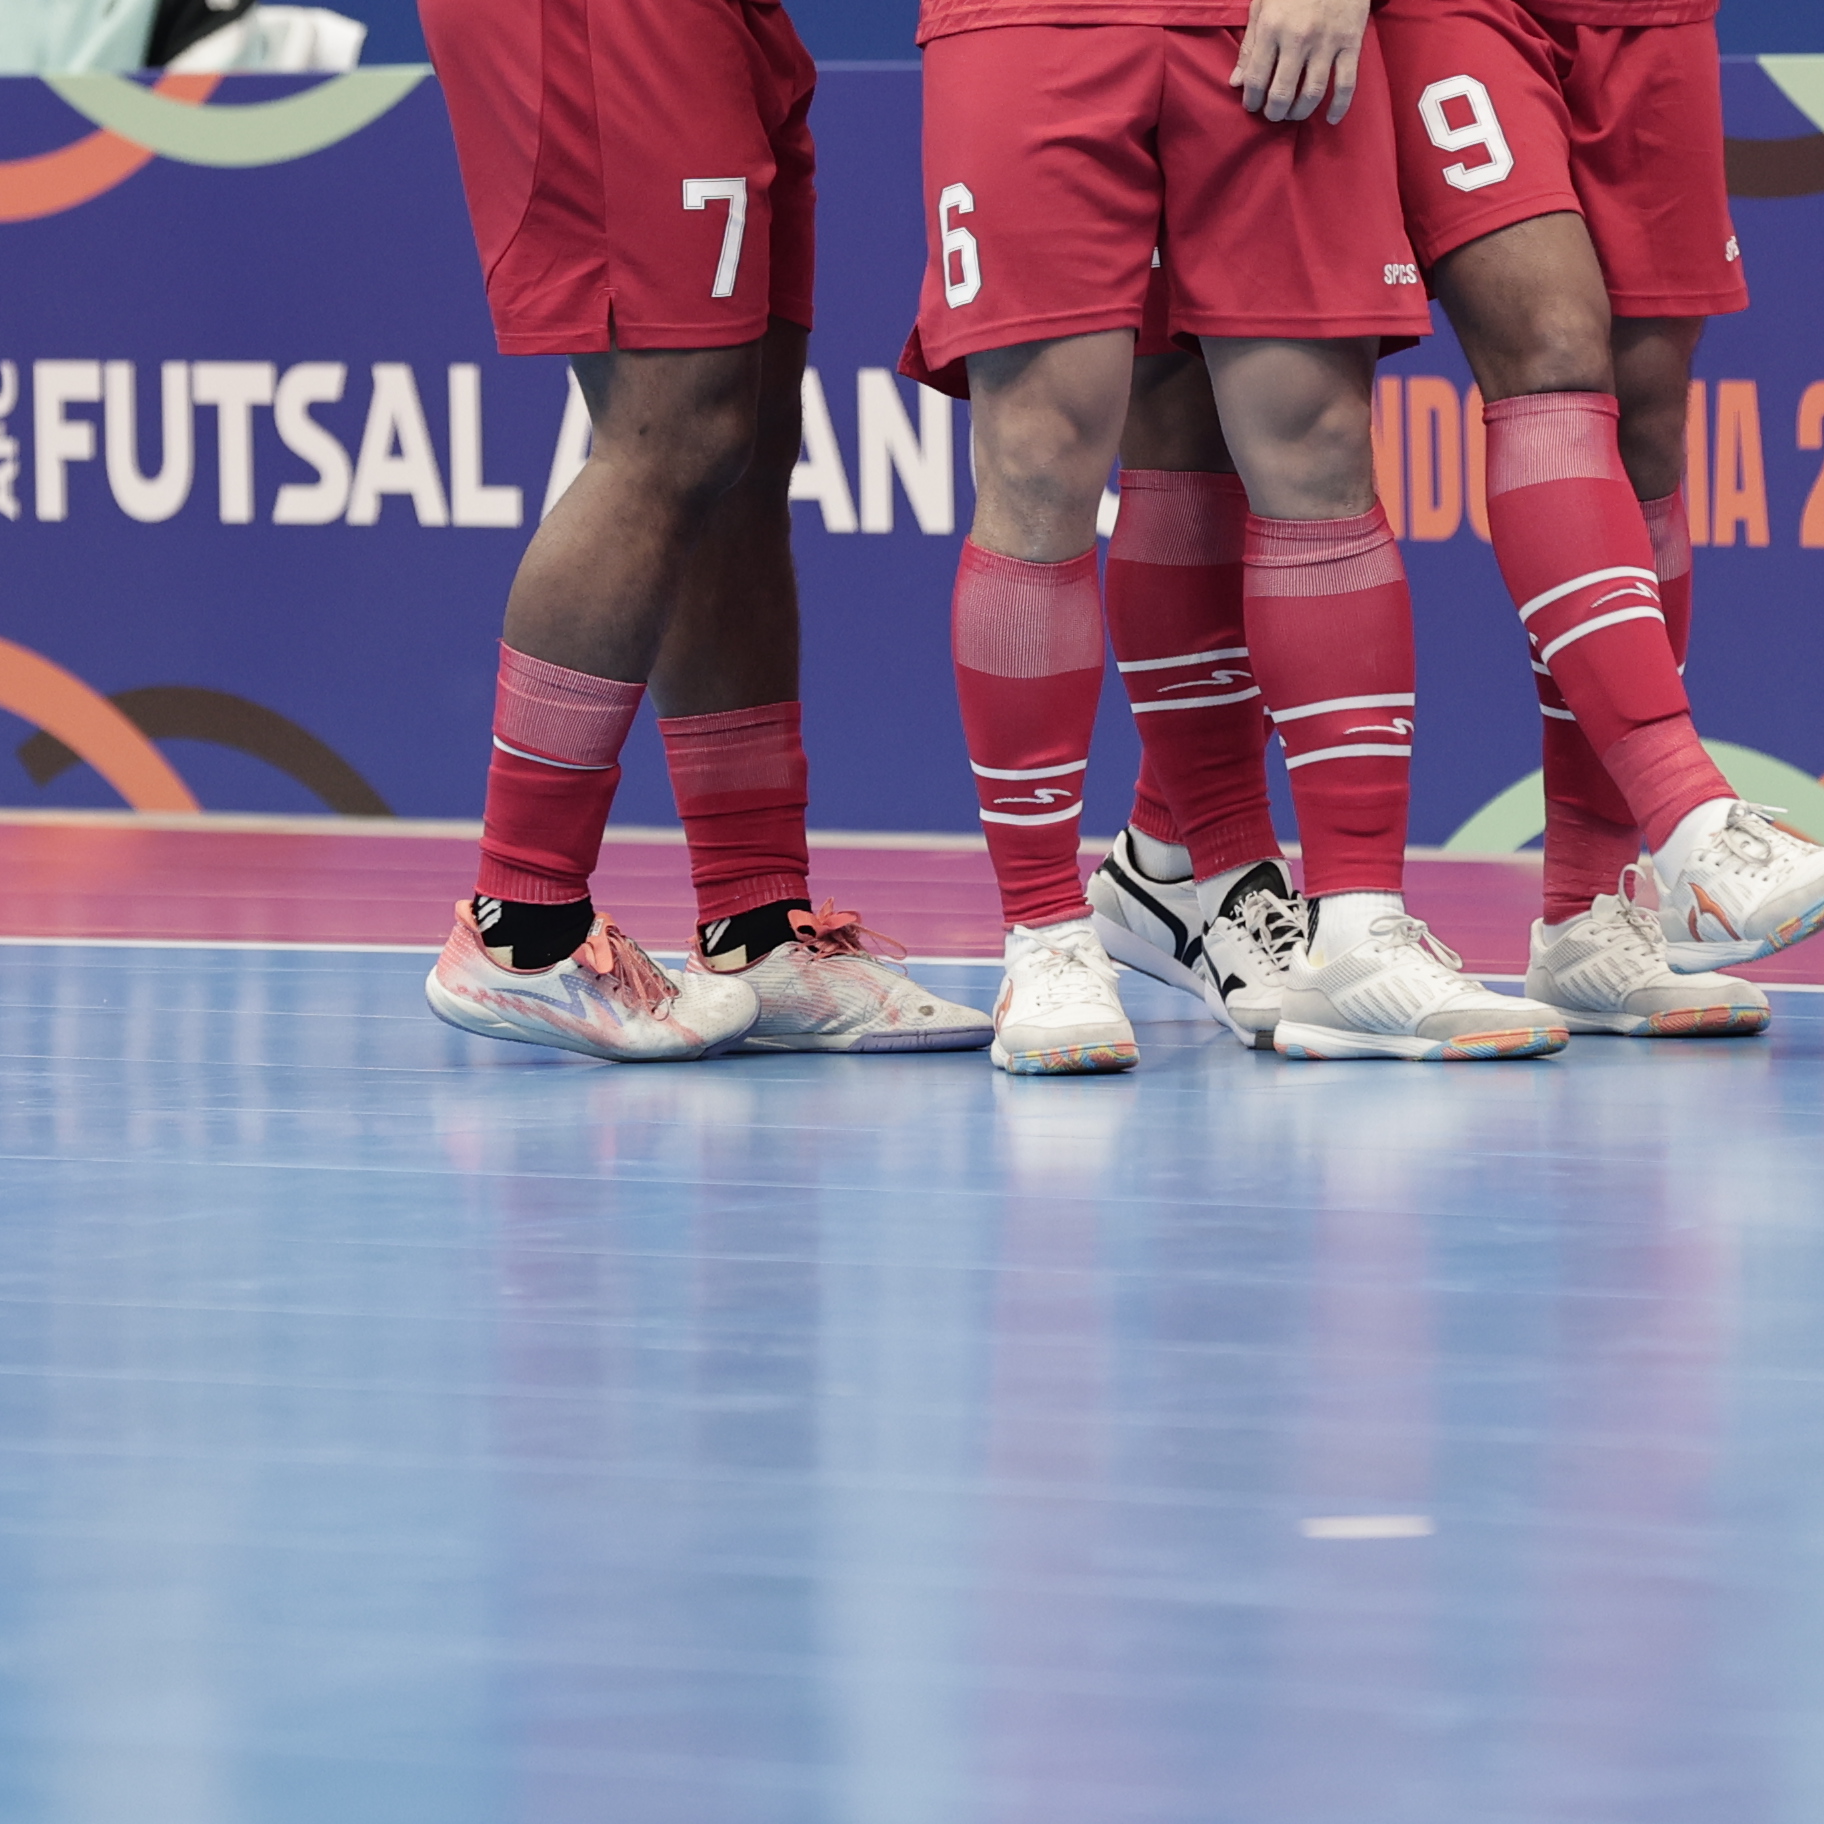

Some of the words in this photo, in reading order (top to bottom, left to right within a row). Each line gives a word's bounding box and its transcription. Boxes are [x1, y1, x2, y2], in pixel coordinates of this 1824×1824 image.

[1417, 74, 1514, 192] 9
[682, 177, 747, 298] 7
[938, 182, 983, 309] 6
[32, 358, 524, 529] FUTSAL
